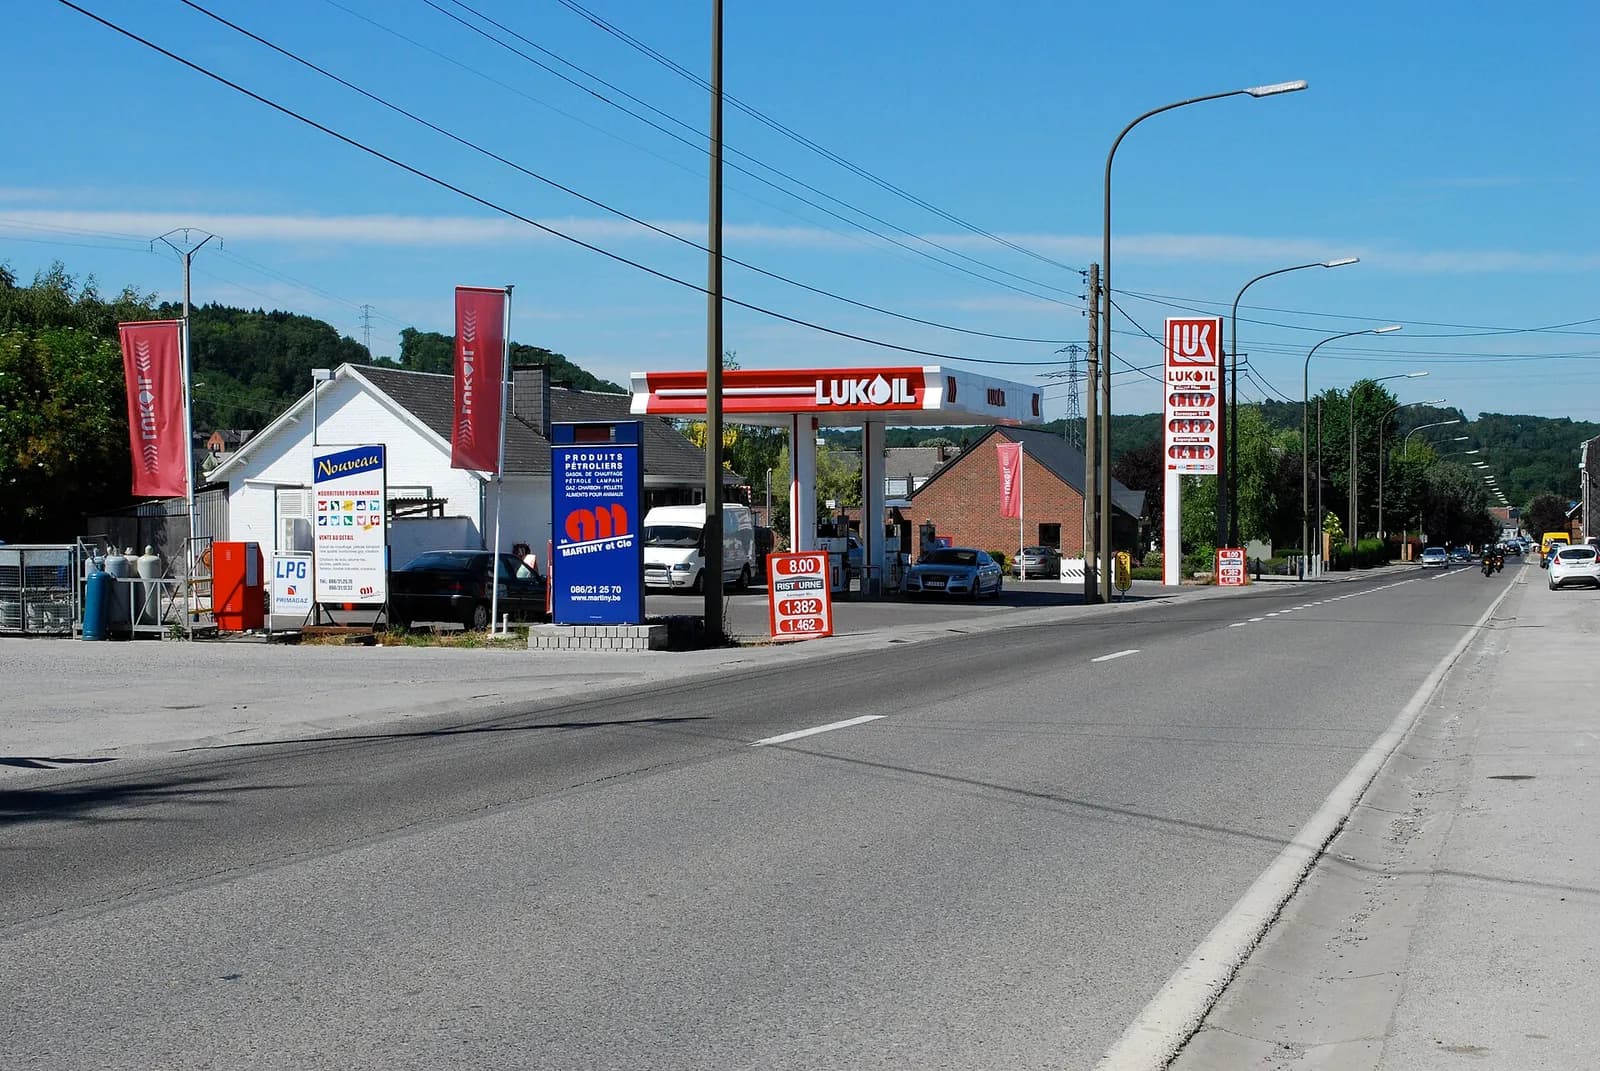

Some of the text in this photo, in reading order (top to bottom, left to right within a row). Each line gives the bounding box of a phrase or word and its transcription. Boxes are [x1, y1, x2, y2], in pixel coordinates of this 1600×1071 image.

[1168, 370, 1216, 382] LUKOIL
[815, 373, 916, 405] LUKOIL
[565, 453, 623, 461] PRODUITS
[317, 455, 379, 479] Nouveau
[565, 461, 623, 470] PÉTROLIERS
[562, 539, 632, 557] MARTINY et Cie
[276, 561, 306, 579] LPG
[789, 558, 814, 573] 8.00
[570, 585, 622, 594] 086/21 25 70
[571, 594, 622, 602] www.martiny.be
[785, 600, 816, 614] 1.382
[788, 619, 816, 631] 1.462
